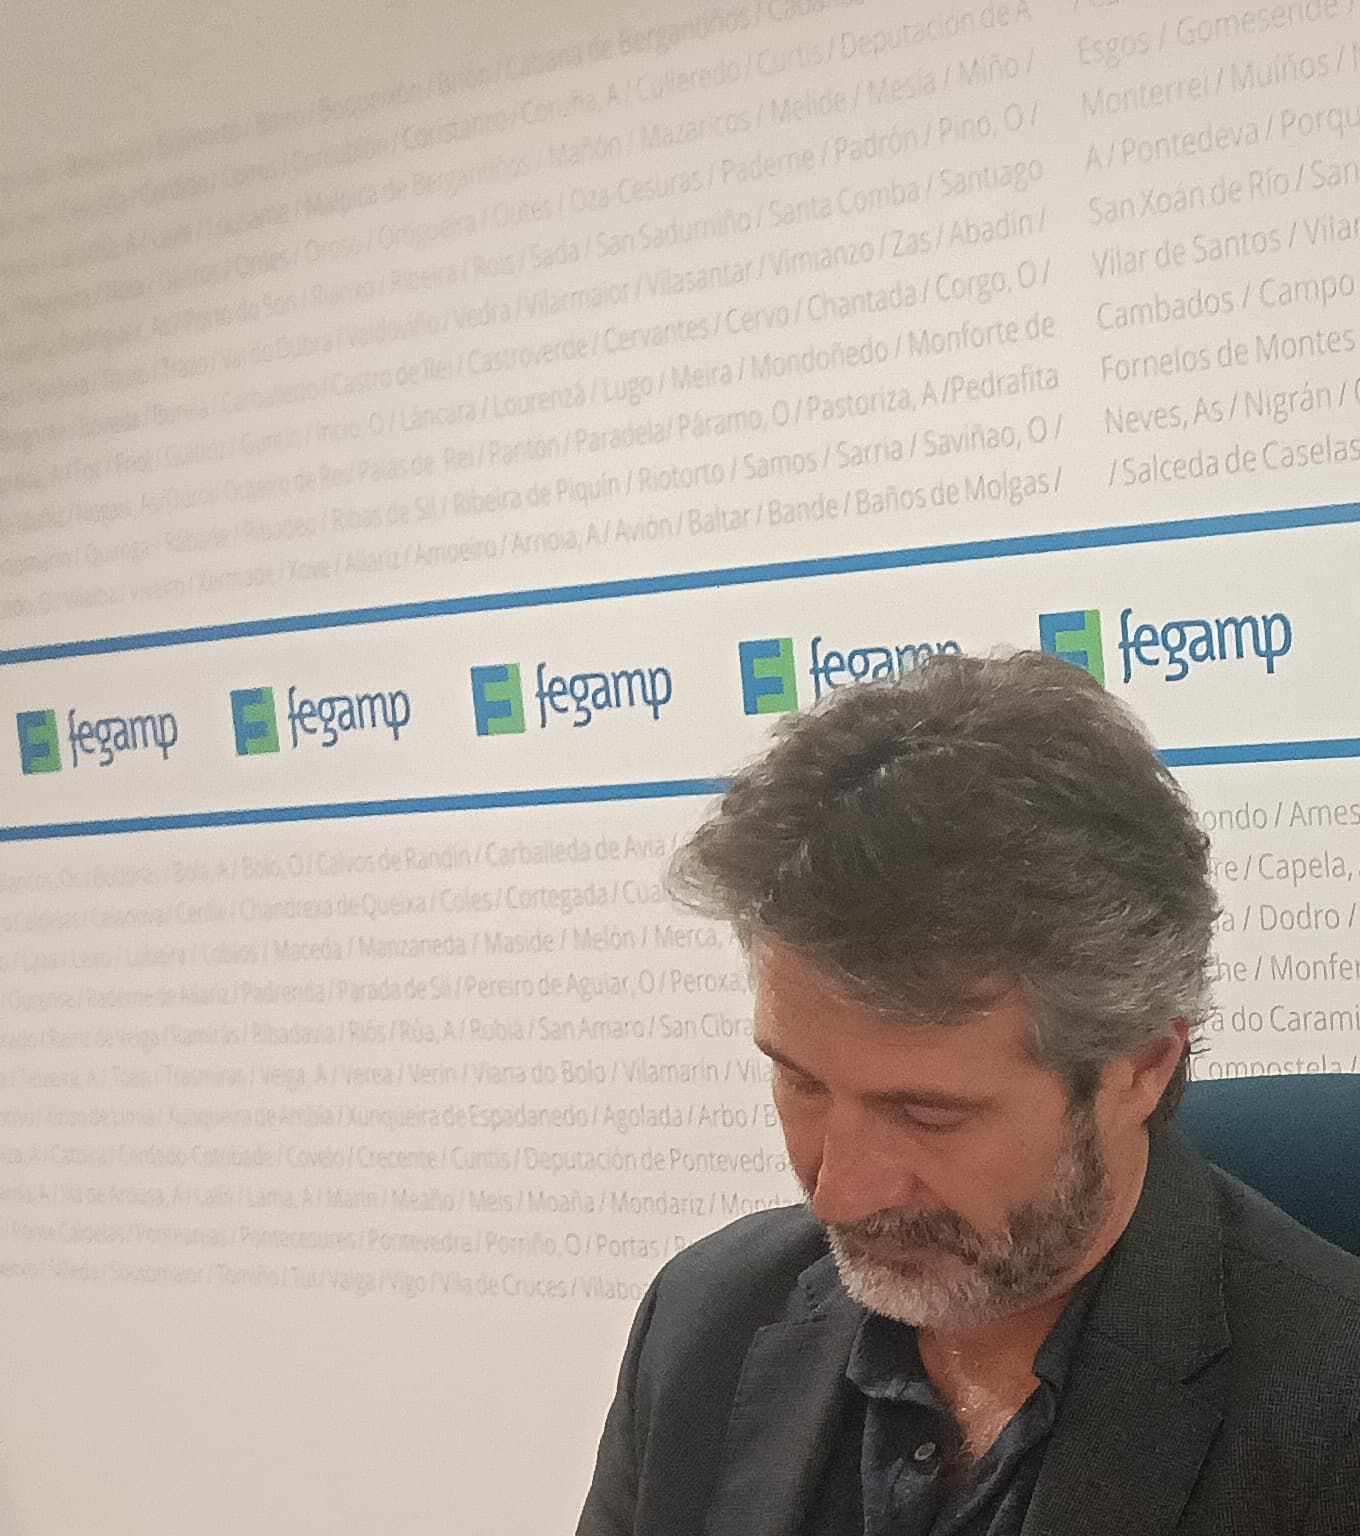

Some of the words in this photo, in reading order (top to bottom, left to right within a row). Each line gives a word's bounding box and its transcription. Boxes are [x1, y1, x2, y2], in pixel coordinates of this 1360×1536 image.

[769, 196, 833, 228] Santa
[837, 178, 920, 209] Comba
[939, 158, 1043, 197] Santiago
[725, 304, 789, 335] Cervo
[807, 280, 917, 319] Chantada
[1017, 260, 1037, 289] O
[1097, 288, 1234, 330] Cambados
[1259, 273, 1354, 308] Campo
[1105, 404, 1188, 434] Neves,
[1193, 395, 1223, 425] As
[1245, 381, 1331, 425] Nigrán
[743, 451, 818, 480] Samos
[836, 439, 903, 469] Sarria
[1027, 414, 1047, 444] O
[1122, 449, 1219, 486] Salceda
[1225, 443, 1256, 475] de
[768, 493, 838, 526] Bande
[855, 484, 926, 516] Baños
[931, 480, 959, 507] de
[964, 471, 1049, 507] Molgas
[1117, 608, 1293, 683] fegamp
[287, 686, 411, 748] fegamp
[535, 662, 673, 727] fegamp
[68, 708, 178, 768] fegamp
[1260, 902, 1340, 932] Dodro
